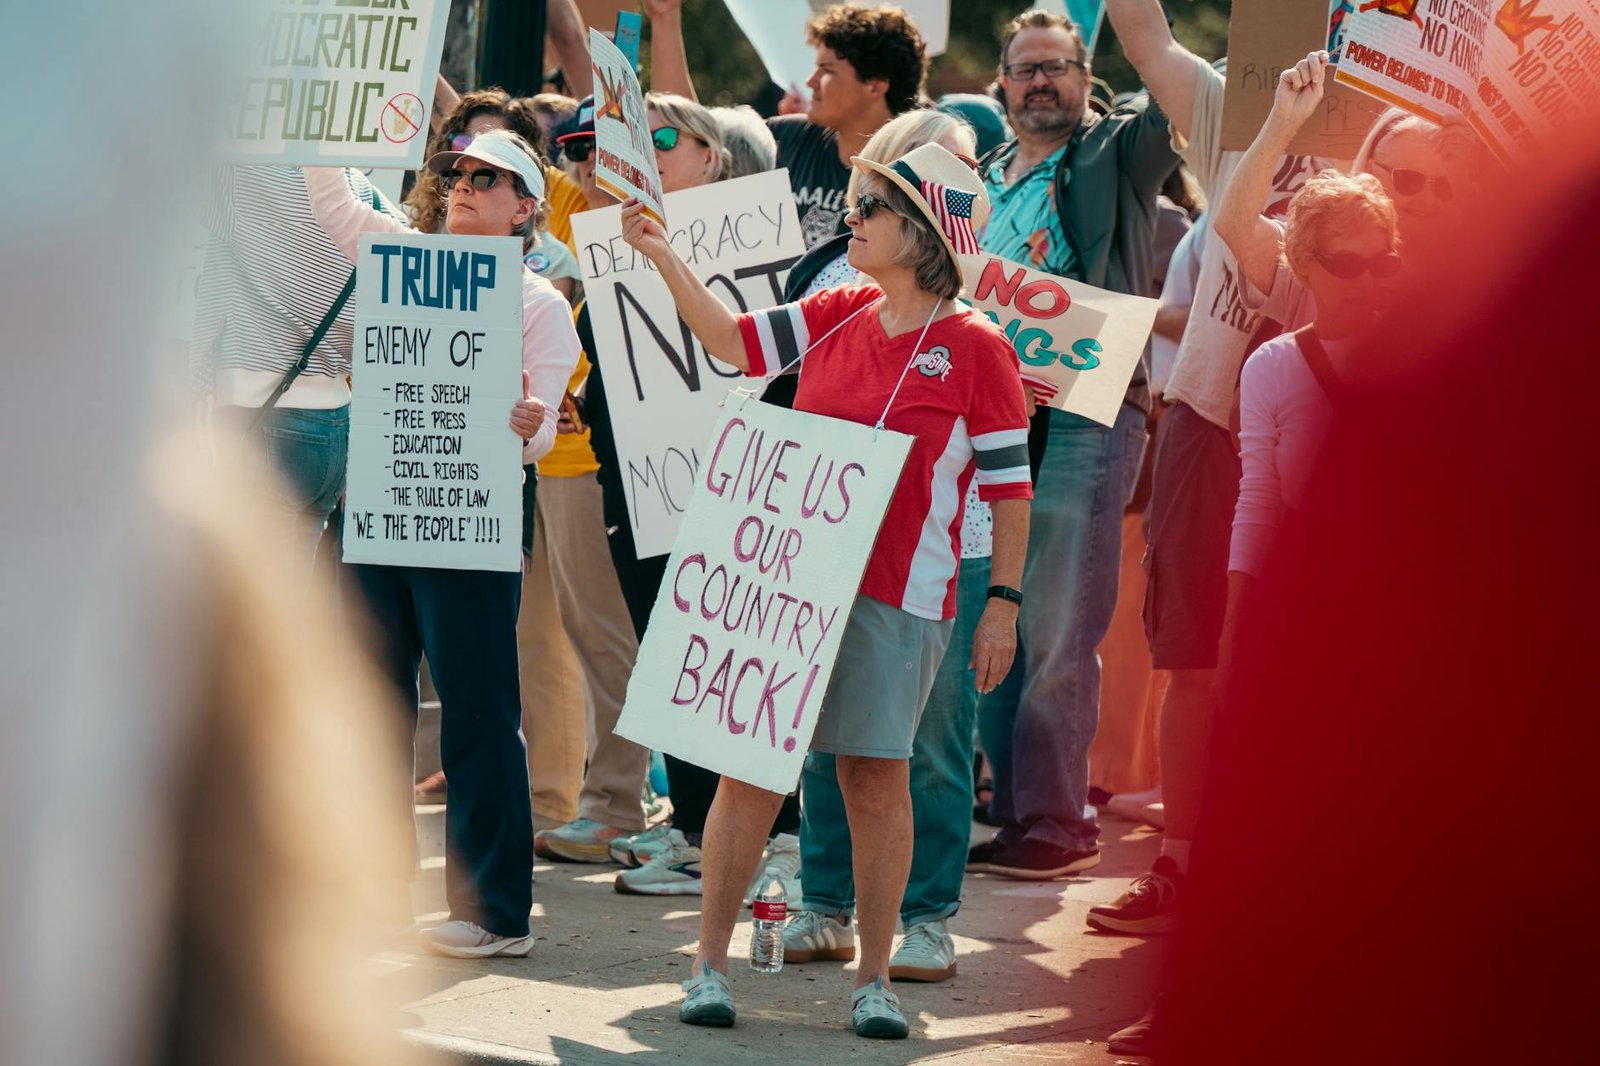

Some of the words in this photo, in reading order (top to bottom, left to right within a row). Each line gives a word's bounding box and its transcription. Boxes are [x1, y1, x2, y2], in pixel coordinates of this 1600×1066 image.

[1419, 16, 1448, 58] NO
[1537, 28, 1565, 60] NO
[1559, 11, 1585, 42] NO
[1345, 40, 1388, 75] POWER
[1386, 58, 1432, 93] BELONGS
[1507, 49, 1548, 88] NO
[371, 244, 496, 311] TRUMP
[974, 258, 1071, 319] NO
[365, 325, 431, 366] ENEMY
[450, 330, 485, 370] OF
[431, 384, 470, 404] SPEECH
[431, 410, 466, 430] PRESS
[433, 462, 479, 480] RIGHTS
[706, 417, 801, 514] GIVE
[415, 486, 445, 507] RULE
[447, 488, 463, 507] OF
[466, 488, 490, 508] LAW
[383, 514, 408, 540] THE
[734, 515, 802, 584] OUR
[673, 551, 840, 665] COUNTRY
[670, 633, 821, 753] BACK!
